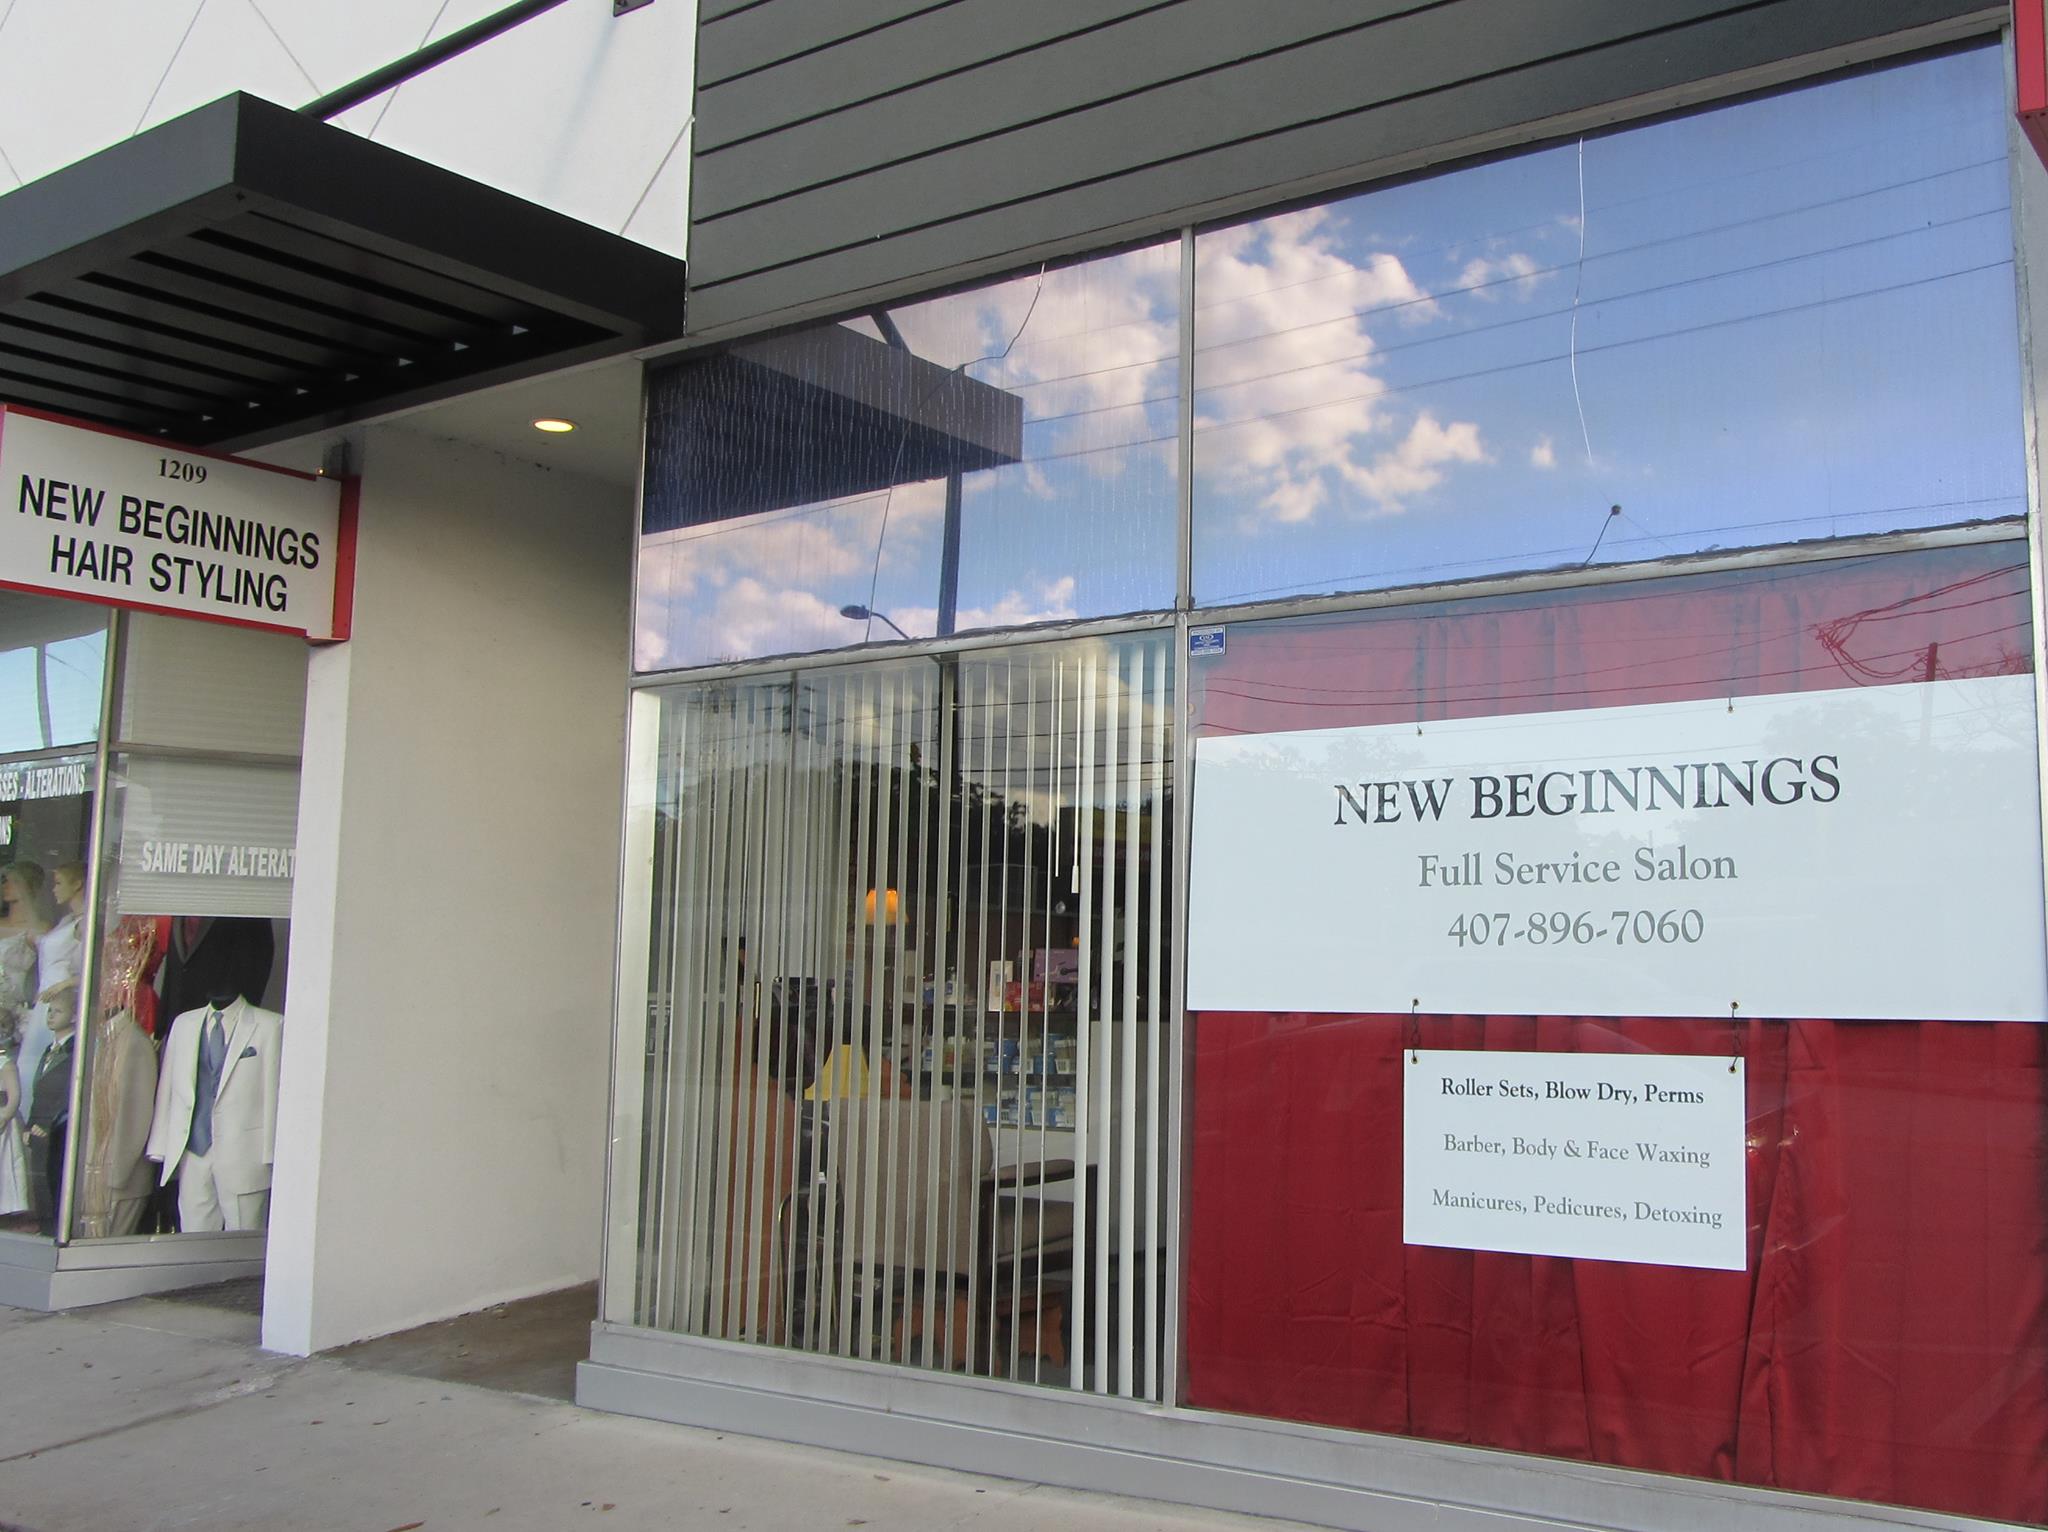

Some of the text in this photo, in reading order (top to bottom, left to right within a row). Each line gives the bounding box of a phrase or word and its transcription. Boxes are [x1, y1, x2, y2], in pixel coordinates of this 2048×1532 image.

[158, 458, 207, 484] 1209
[18, 474, 320, 570] NEW BEGINNINGS
[50, 534, 287, 612] HAIR STYLING
[24, 763, 86, 800] ALTERATIONS
[1334, 755, 1841, 825] NEW BEGINNINGS
[142, 841, 188, 873] SAME
[191, 842, 225, 875] DAY
[1418, 845, 1738, 887] Full Service Salon
[1448, 908, 1704, 947] 407-896-7060
[1441, 1078, 1704, 1105] Roller Sets, Blow Dry, Perms
[1444, 1134, 1710, 1168] Barber, Body & Face Waxing
[1432, 1189, 1723, 1230] Manicures, Pedicures, Detoxing
